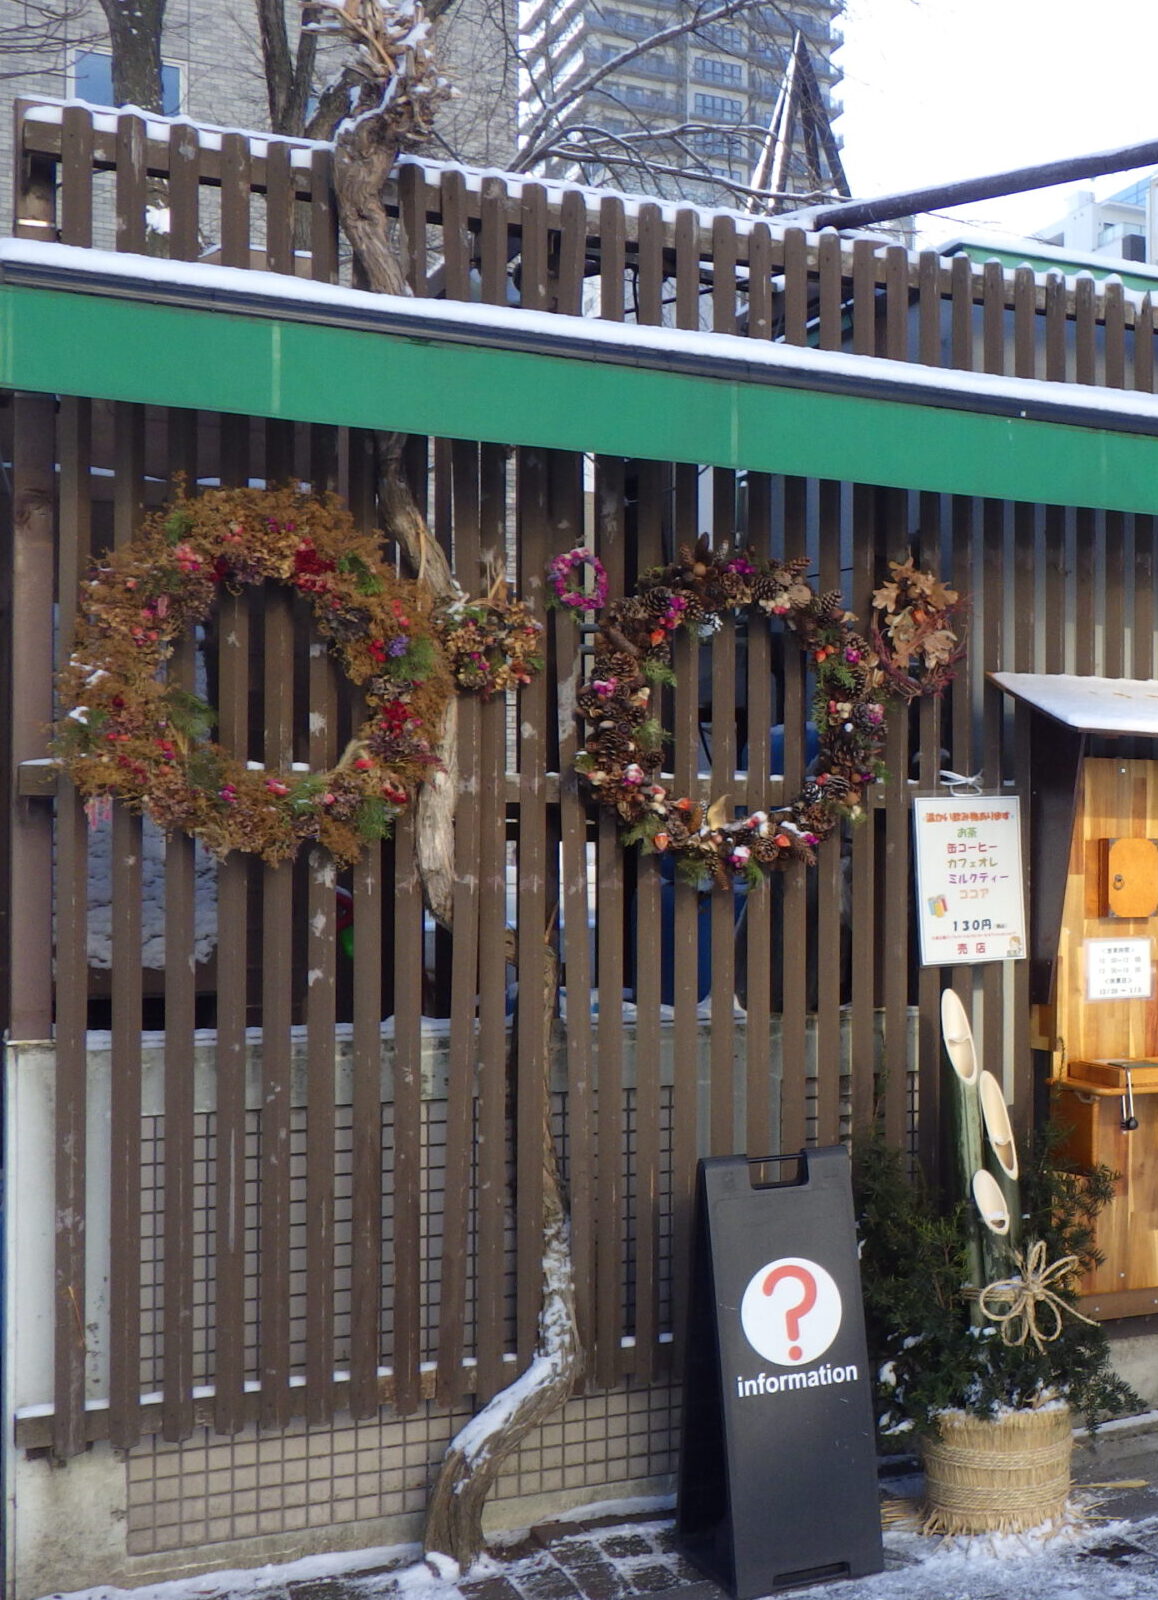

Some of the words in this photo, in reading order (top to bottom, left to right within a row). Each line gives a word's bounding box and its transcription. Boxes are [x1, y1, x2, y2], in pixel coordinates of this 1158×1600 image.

[957, 826, 977, 838] お茶
[947, 842, 998, 854] 缶コーヒー
[947, 857, 998, 869] カフェオレ
[948, 872, 1009, 885] ミルクティー
[960, 888, 990, 900] ココア
[953, 918, 992, 932] 130円
[957, 942, 986, 955] 売店
[737, 1363, 858, 1397] information
